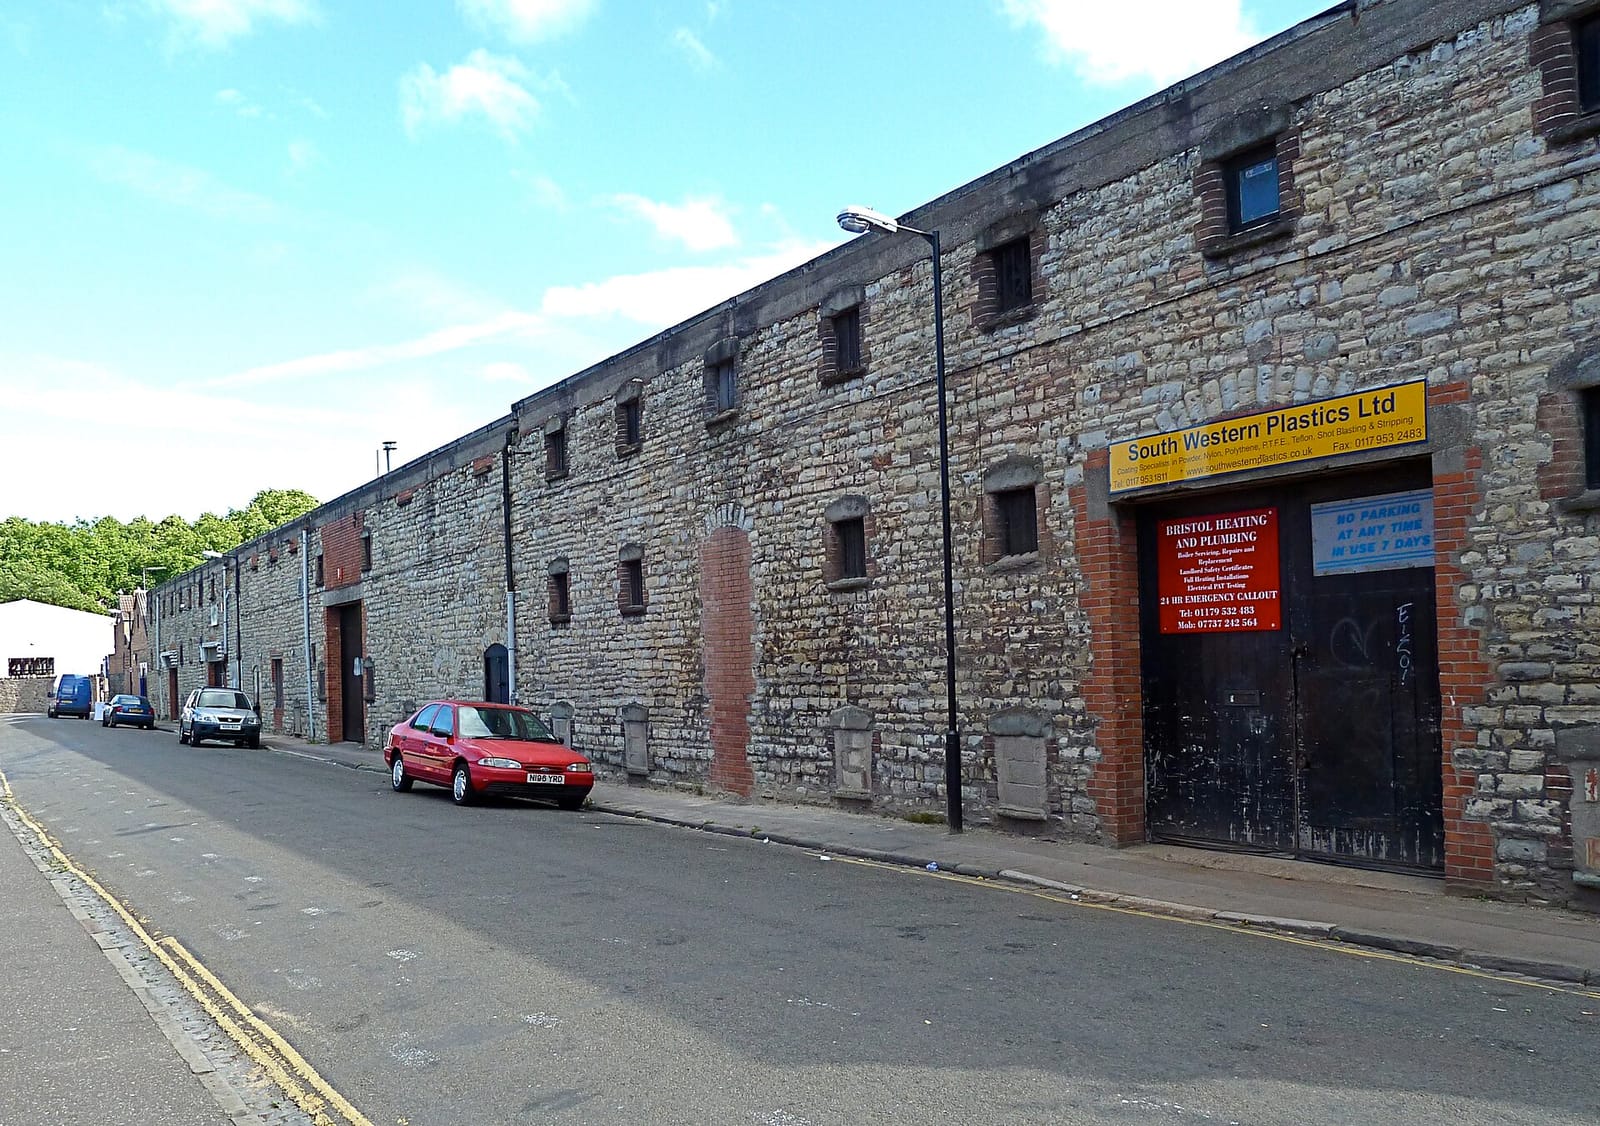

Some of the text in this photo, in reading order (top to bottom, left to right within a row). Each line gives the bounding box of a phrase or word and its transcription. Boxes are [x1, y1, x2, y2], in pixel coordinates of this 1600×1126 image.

[1128, 392, 1395, 461] South Western Plastics Ltd
[1117, 465, 1138, 475] Coating
[1139, 460, 1169, 472] Specialists
[1204, 450, 1223, 461] Nylon,
[1225, 443, 1260, 456] Polythene,
[1292, 433, 1315, 444] Teflon,
[1317, 428, 1335, 440] Shot
[1336, 423, 1366, 435] Blasting
[1368, 422, 1374, 430] &
[1377, 416, 1413, 429] Stripping
[1332, 442, 1352, 452] Fax:
[1376, 433, 1394, 444] 953
[1397, 428, 1422, 440] 2483
[1186, 447, 1313, 476] www.southwesternplastics.co.uk
[1337, 504, 1420, 524] NO PARKING
[1166, 515, 1267, 535] BRISTOL HEATING
[1338, 520, 1422, 540] AT ANY TIME
[1176, 532, 1257, 548] AND PLUMBING
[1332, 547, 1344, 556] IN
[1350, 543, 1376, 554] USE
[1382, 541, 1389, 550] 7
[1172, 596, 1183, 604] HR
[1185, 594, 1235, 603] EMERGENCY
[1237, 591, 1277, 600] CALLOUT
[1195, 608, 1219, 616] 01179
[1222, 607, 1239, 615] 532
[1240, 606, 1254, 614] 483
[1198, 620, 1222, 628] 07737
[1225, 619, 1240, 627] 242
